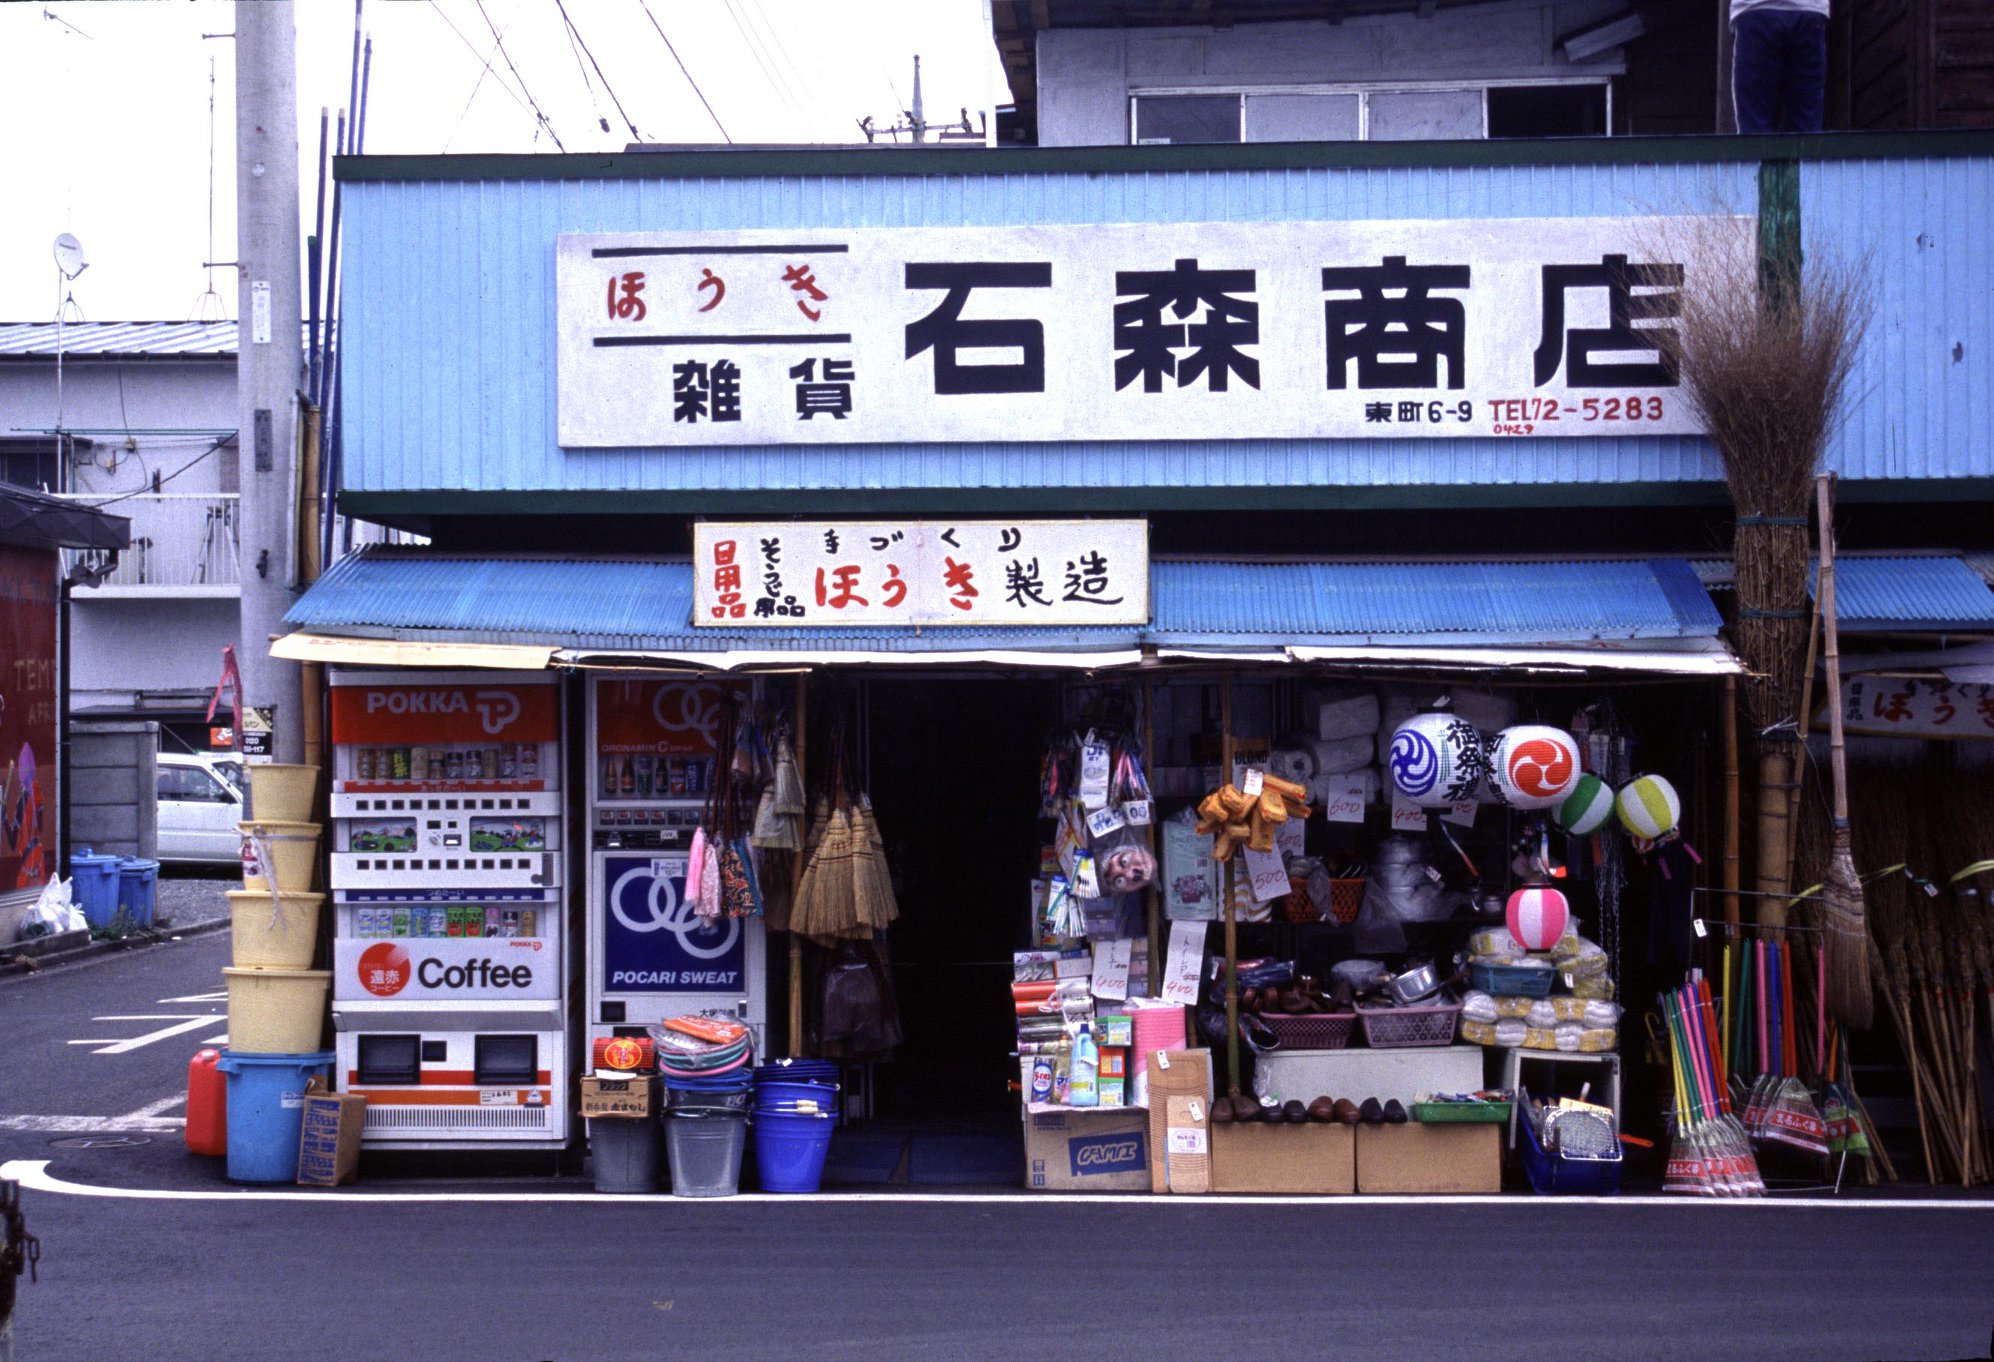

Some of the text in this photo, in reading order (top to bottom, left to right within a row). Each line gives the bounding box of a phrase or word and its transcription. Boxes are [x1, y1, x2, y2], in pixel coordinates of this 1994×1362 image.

[608, 264, 828, 322] ほうき
[905, 254, 1684, 394] 石森商店
[673, 357, 855, 423] 雑貨
[1494, 425, 1534, 435] 0429
[824, 527, 1021, 553] 手づくり
[712, 540, 747, 618] 日用品
[367, 692, 469, 714] POKKA
[658, 740, 668, 752] C
[418, 957, 532, 989] Coffee
[612, 971, 737, 984] POCARI SWEAT
